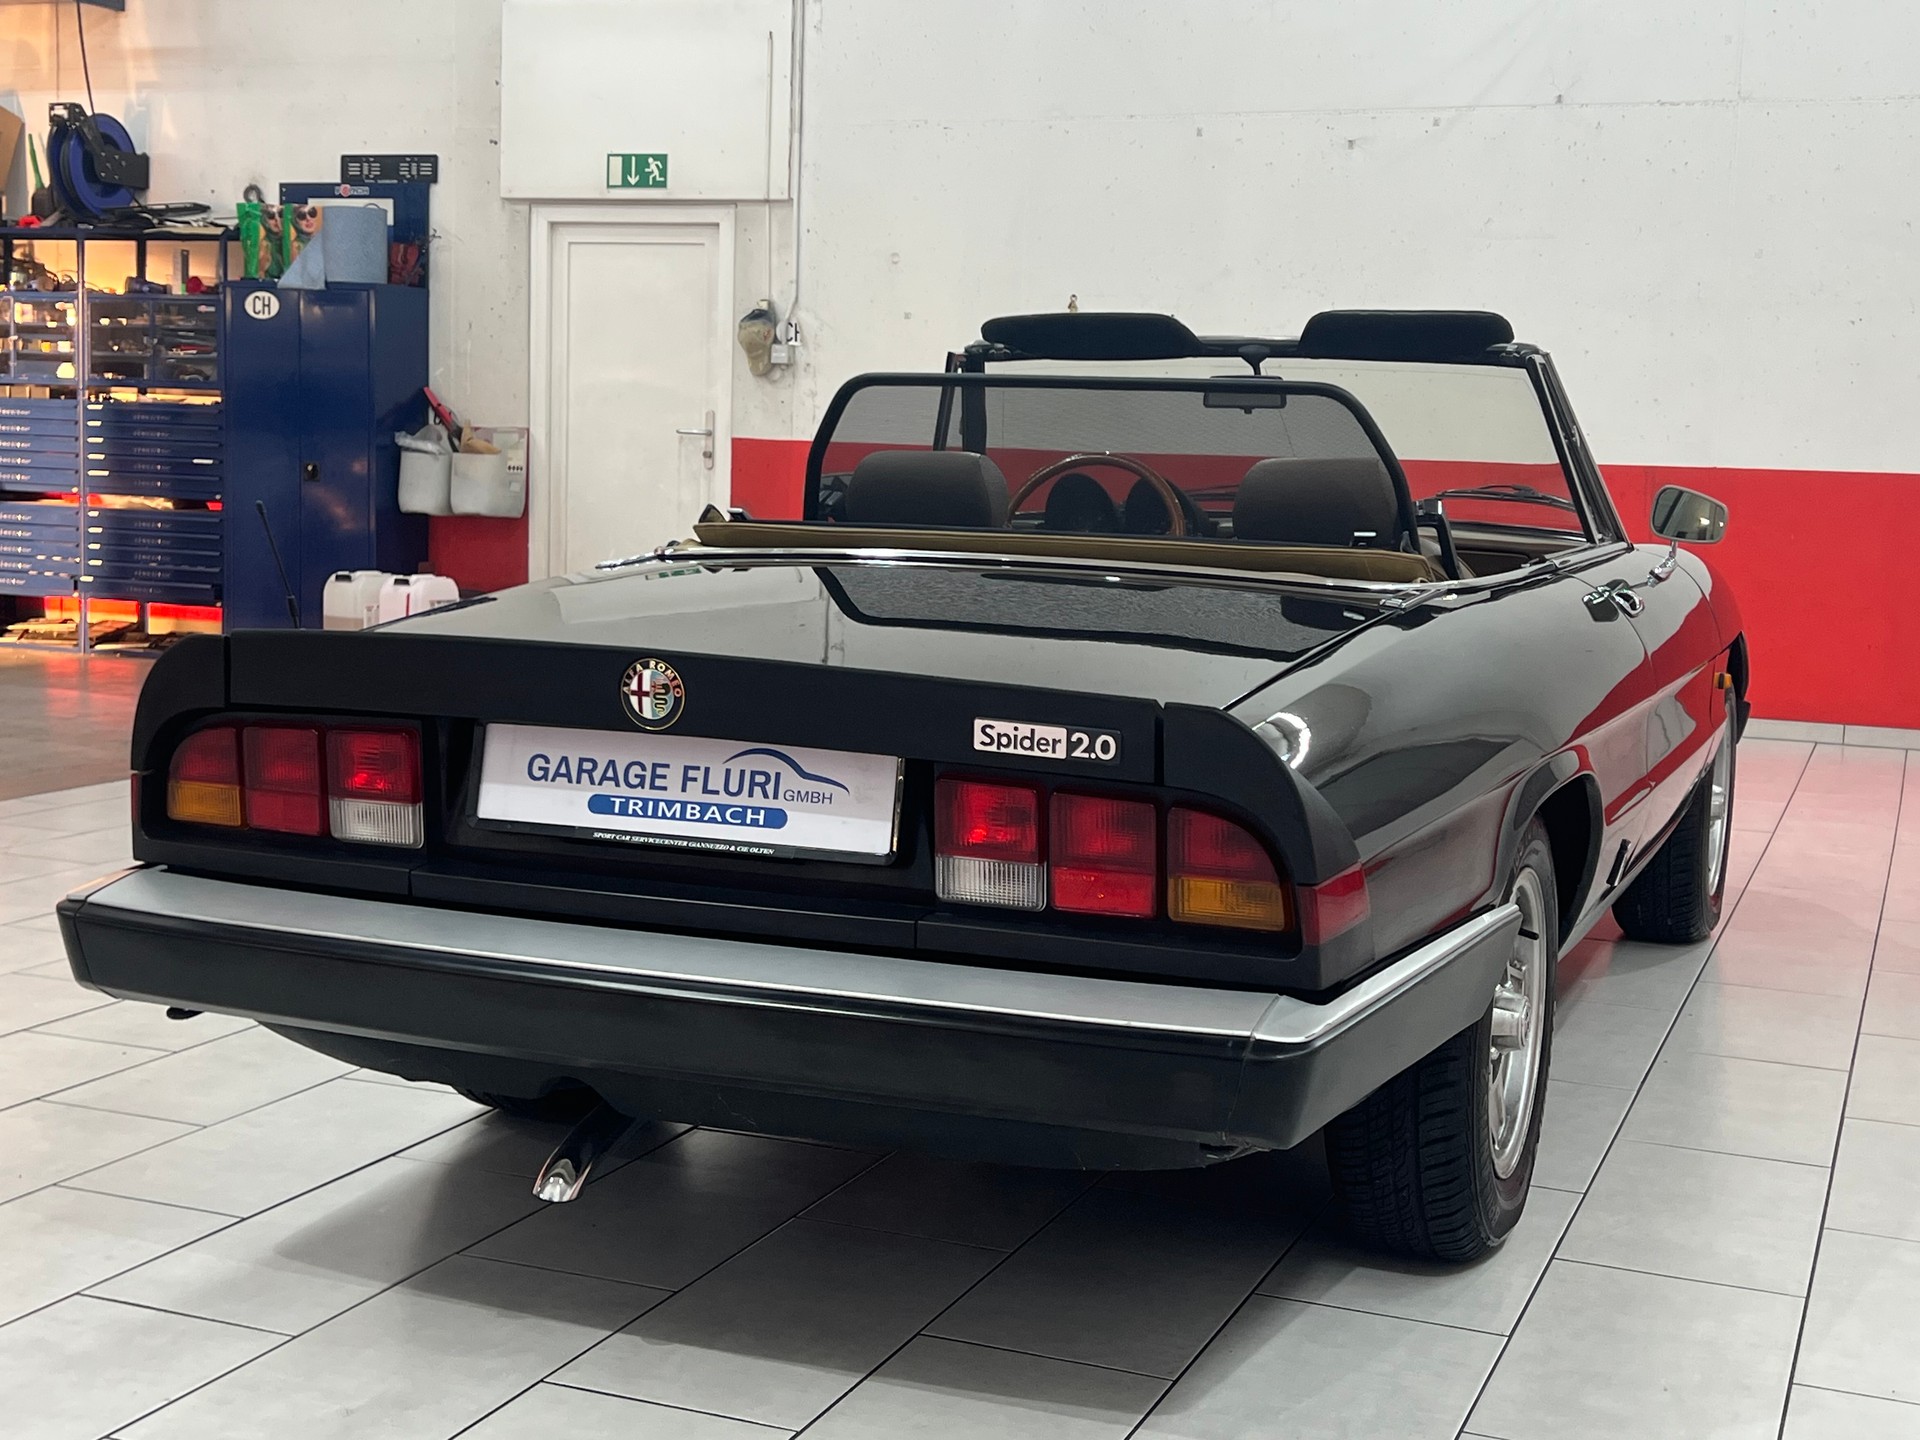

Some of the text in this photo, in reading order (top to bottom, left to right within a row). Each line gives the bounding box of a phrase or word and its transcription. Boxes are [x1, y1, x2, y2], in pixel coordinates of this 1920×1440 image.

[252, 296, 271, 316] CH
[622, 660, 682, 698] ALFA ROMEO
[979, 724, 1117, 761] Spider 2.0
[527, 753, 833, 805] GARAGE FLURI GMBH
[609, 797, 766, 826] TRIMBACH
[749, 847, 775, 855] OLTEN
